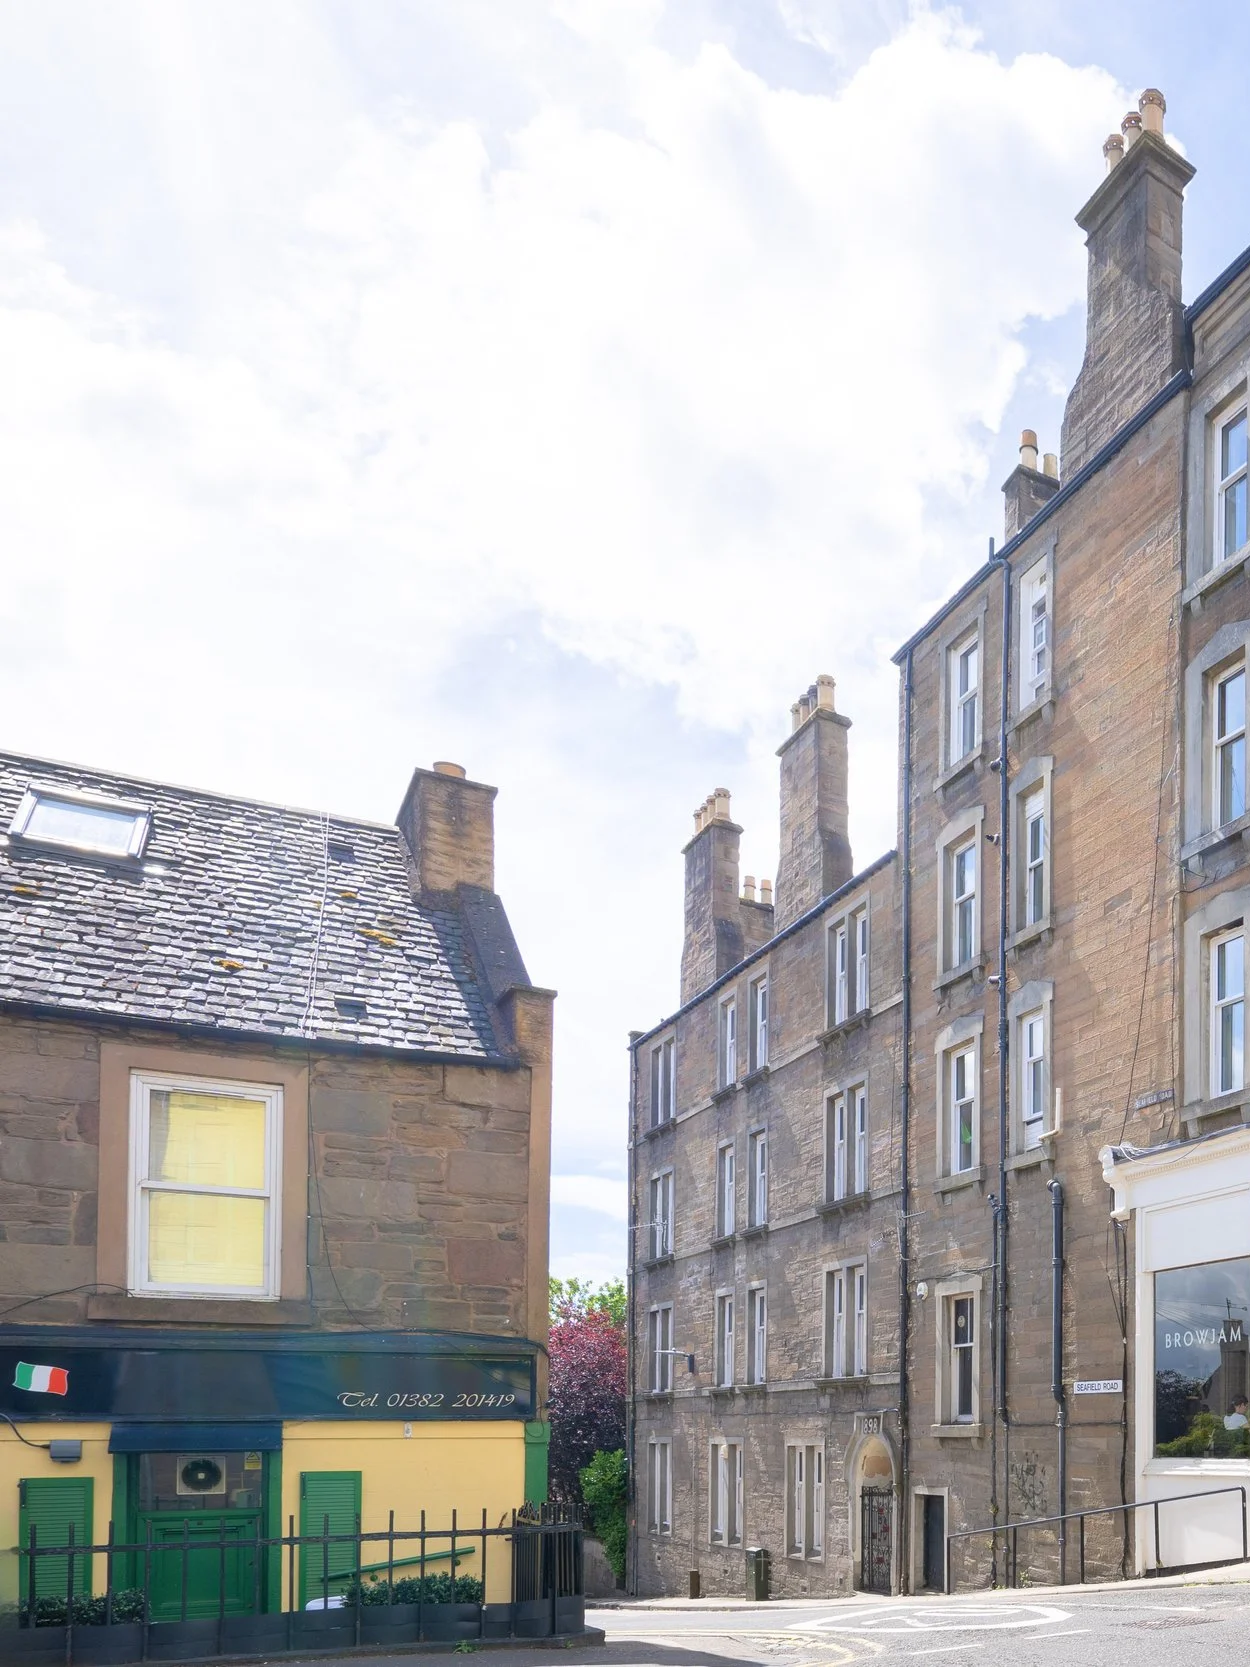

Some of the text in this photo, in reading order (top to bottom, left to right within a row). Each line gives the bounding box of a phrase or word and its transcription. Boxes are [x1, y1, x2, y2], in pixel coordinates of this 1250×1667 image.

[1165, 1326, 1242, 1349] BROWJAM
[1076, 1382, 1119, 1392] SEAFIELD ROAD
[336, 1391, 516, 1408] Tel. 01382 201419
